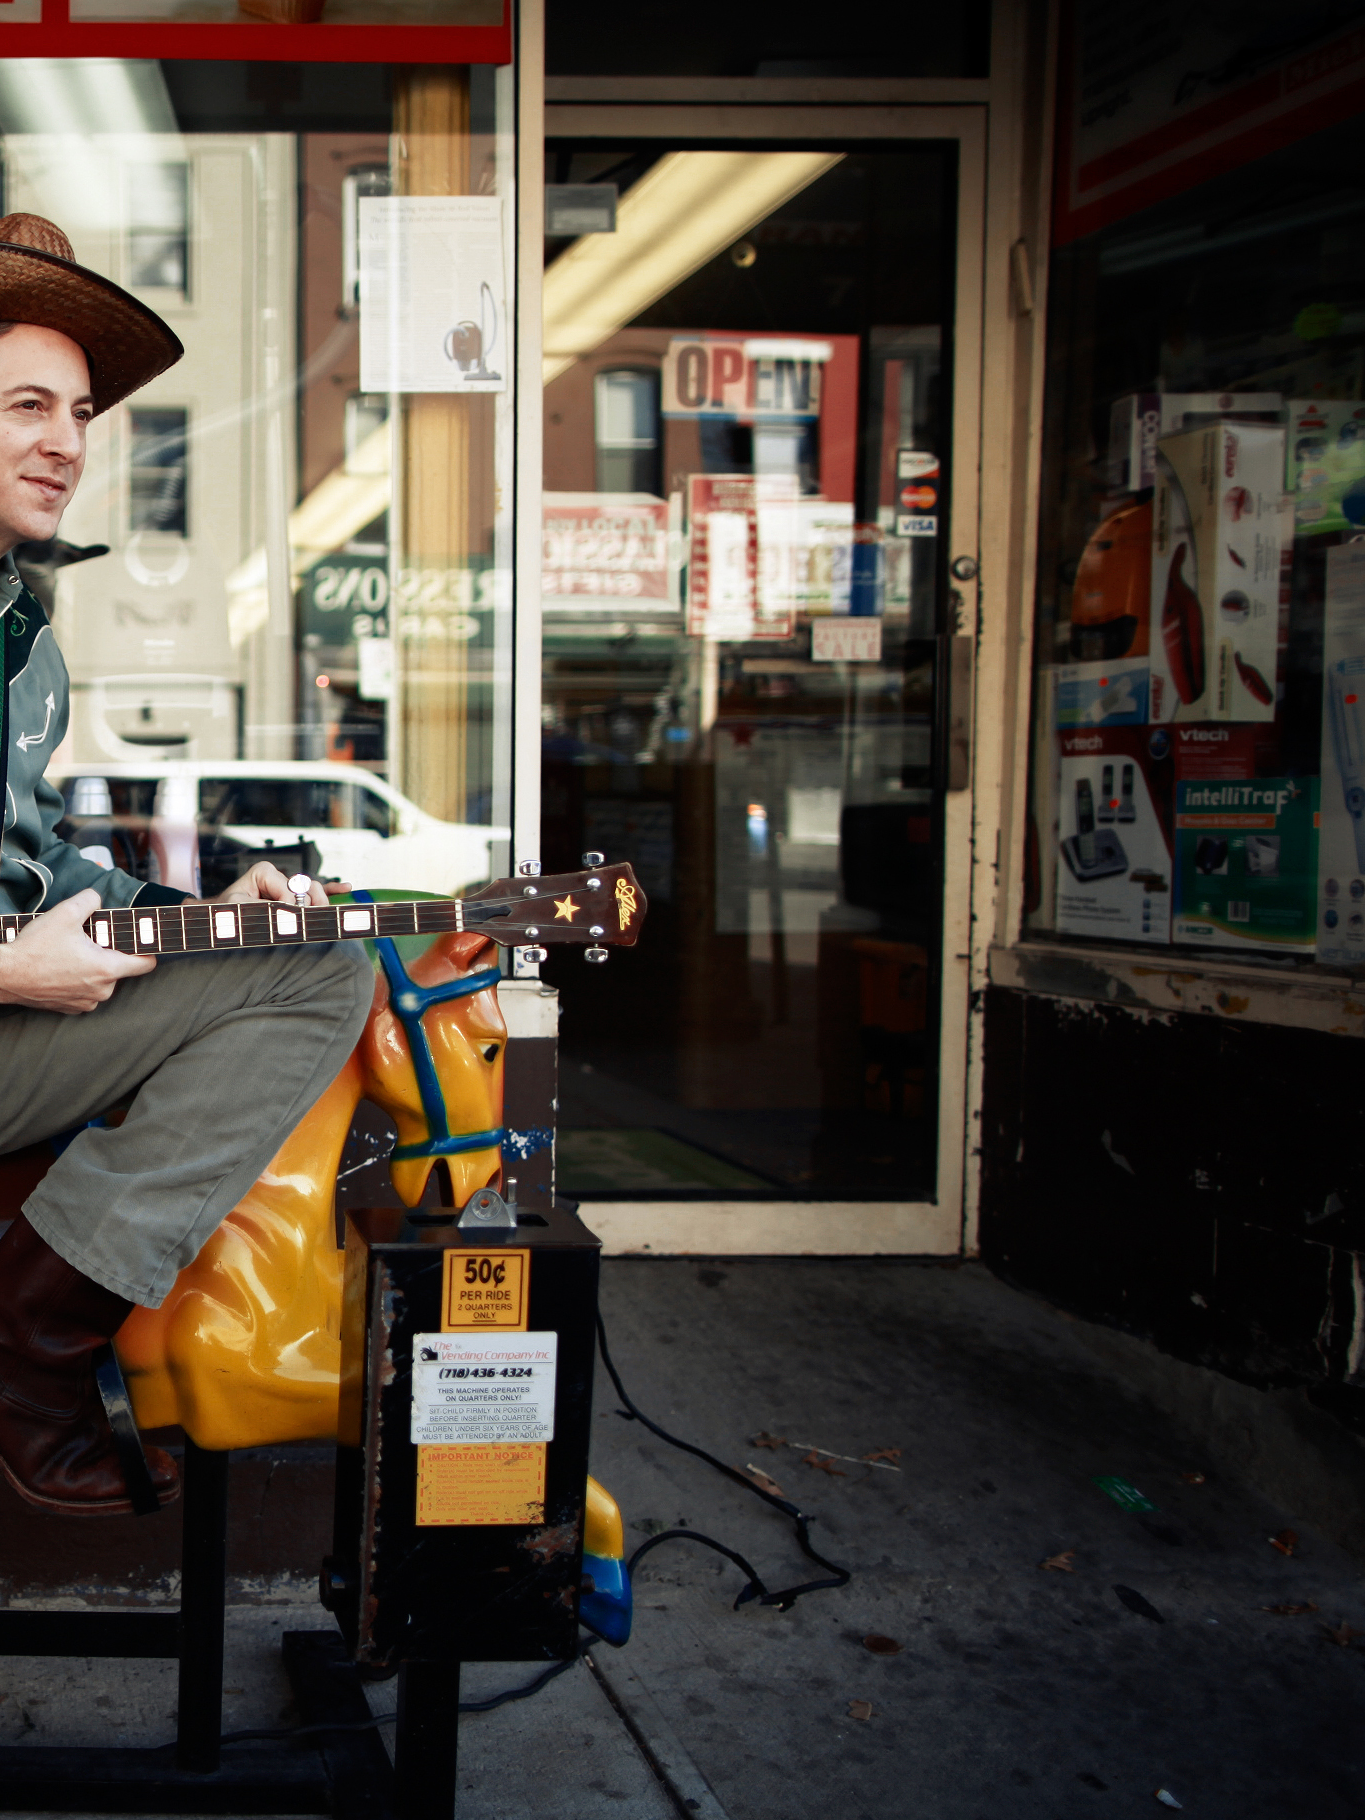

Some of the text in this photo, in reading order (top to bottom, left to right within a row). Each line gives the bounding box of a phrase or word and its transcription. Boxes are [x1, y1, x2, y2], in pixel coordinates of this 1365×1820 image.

[677, 346, 811, 410] OPEN
[902, 519, 934, 531] VISA
[814, 641, 877, 660] SALE
[1180, 728, 1229, 742] vtech
[1064, 735, 1103, 751] vtech
[1185, 786, 1289, 815] intelliTrap
[464, 1258, 505, 1288] 50¢
[460, 1290, 511, 1300] PER RIDE
[433, 1341, 452, 1350] The
[441, 1350, 549, 1362] Vending Company Inc
[494, 1452, 534, 1460] NOTICE
